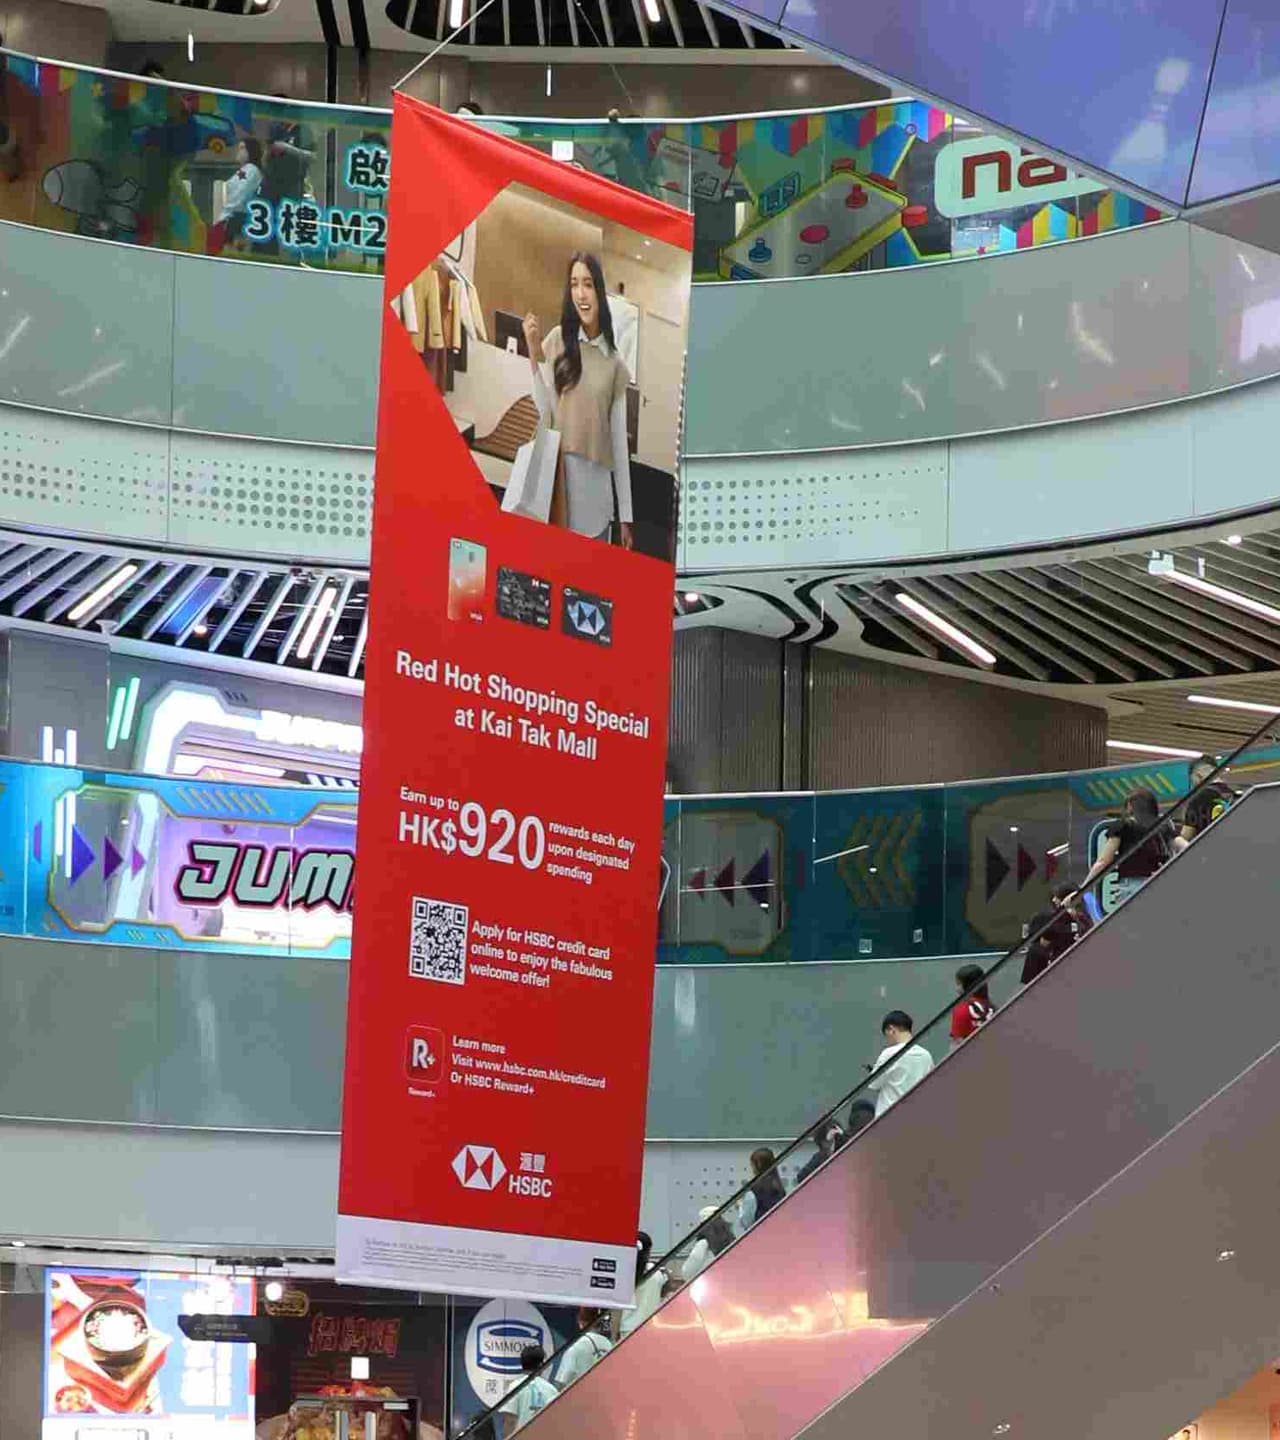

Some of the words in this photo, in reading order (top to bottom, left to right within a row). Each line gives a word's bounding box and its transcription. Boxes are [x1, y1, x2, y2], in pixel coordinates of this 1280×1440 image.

[962, 150, 1068, 199] na
[396, 651, 437, 684] Red
[444, 664, 481, 695] Hot
[487, 676, 579, 723] Shopping
[584, 701, 649, 739] Special
[454, 710, 474, 729] at
[480, 711, 513, 737] Kai
[519, 718, 551, 750] Tak
[558, 728, 598, 760] Mall
[400, 787, 427, 803] Earn
[430, 795, 445, 810] up
[448, 796, 459, 811] to
[398, 802, 545, 870] HK$920
[549, 821, 589, 841] rewards
[592, 829, 614, 846] each
[617, 834, 635, 853] day
[548, 843, 574, 861] upon
[577, 848, 630, 870] designated
[181, 839, 353, 911] JUM
[546, 862, 593, 884] spending
[472, 920, 504, 942] Apply
[507, 927, 521, 942] for
[524, 931, 555, 949] HSBC
[557, 939, 587, 956] credit
[588, 946, 610, 960] card
[470, 964, 519, 981] welcome
[471, 944, 504, 959] online
[507, 949, 518, 962] to
[520, 952, 549, 971] enjoy
[552, 955, 568, 971] the
[570, 959, 614, 981] fabulous
[452, 1036, 480, 1050] Learn
[482, 1041, 506, 1055] more
[452, 1053, 473, 1068] Visit
[451, 1071, 463, 1084] Or
[465, 1074, 493, 1089] HSBC
[508, 1174, 552, 1198] HSBC
